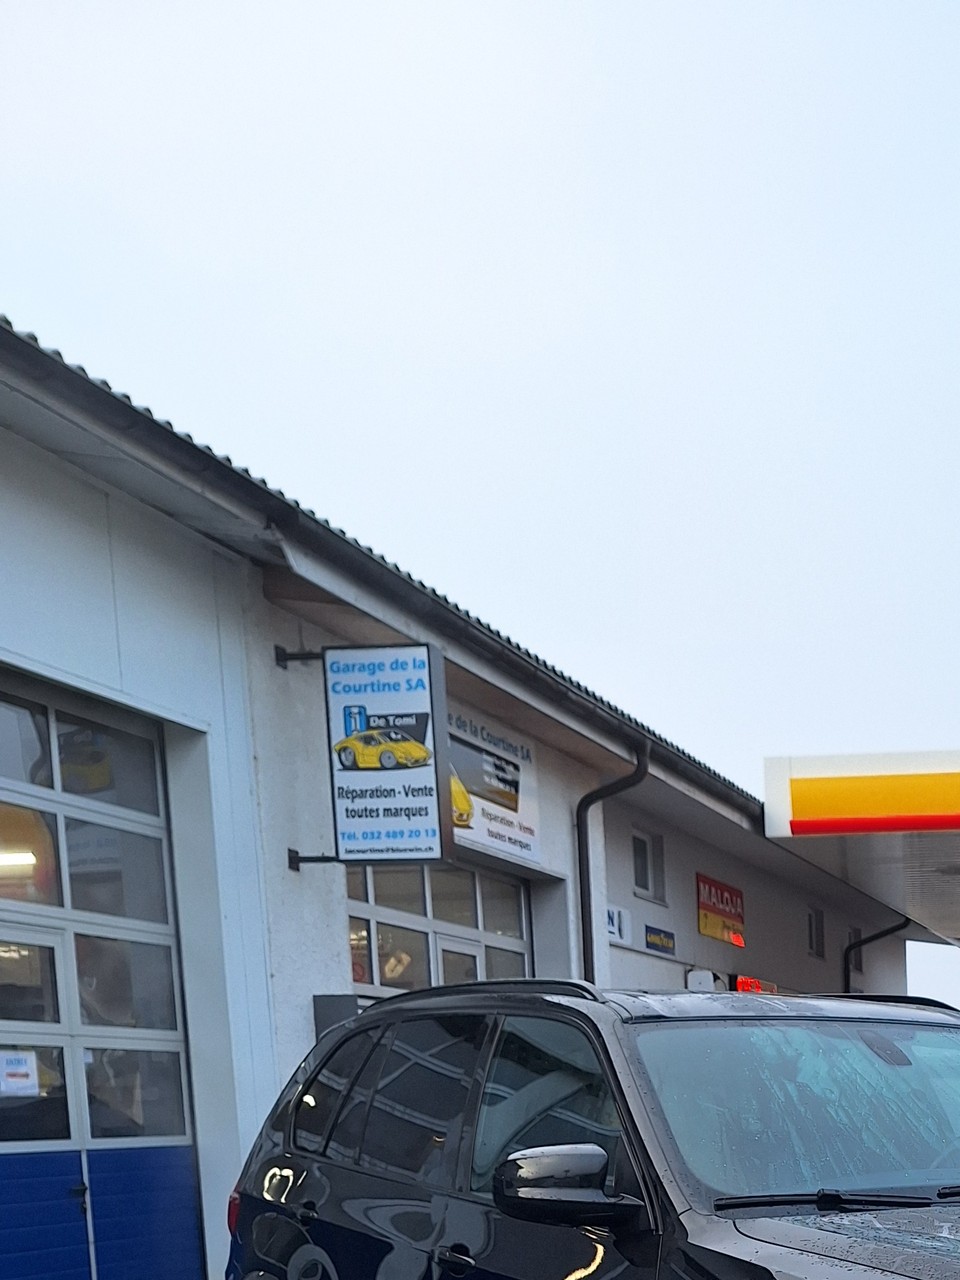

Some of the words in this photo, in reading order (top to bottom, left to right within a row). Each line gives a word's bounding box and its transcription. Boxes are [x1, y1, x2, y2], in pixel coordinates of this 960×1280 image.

[329, 661, 385, 675] Garage
[390, 658, 408, 671] de
[413, 657, 426, 669] la
[331, 680, 401, 694] Courtine
[405, 678, 426, 691] SA
[369, 715, 386, 727] De
[387, 714, 417, 726] Tomi
[456, 714, 468, 732] de
[470, 719, 478, 737] la
[480, 726, 519, 757] Courtine
[521, 745, 532, 764] SA
[337, 785, 396, 803] Réparation
[402, 784, 434, 798] Vente
[345, 806, 380, 819] toutes
[382, 806, 429, 821] marques
[340, 831, 359, 841] Tél.
[362, 831, 382, 840] 032
[384, 830, 404, 839] 489
[408, 829, 421, 839] 20
[425, 828, 437, 838] 13
